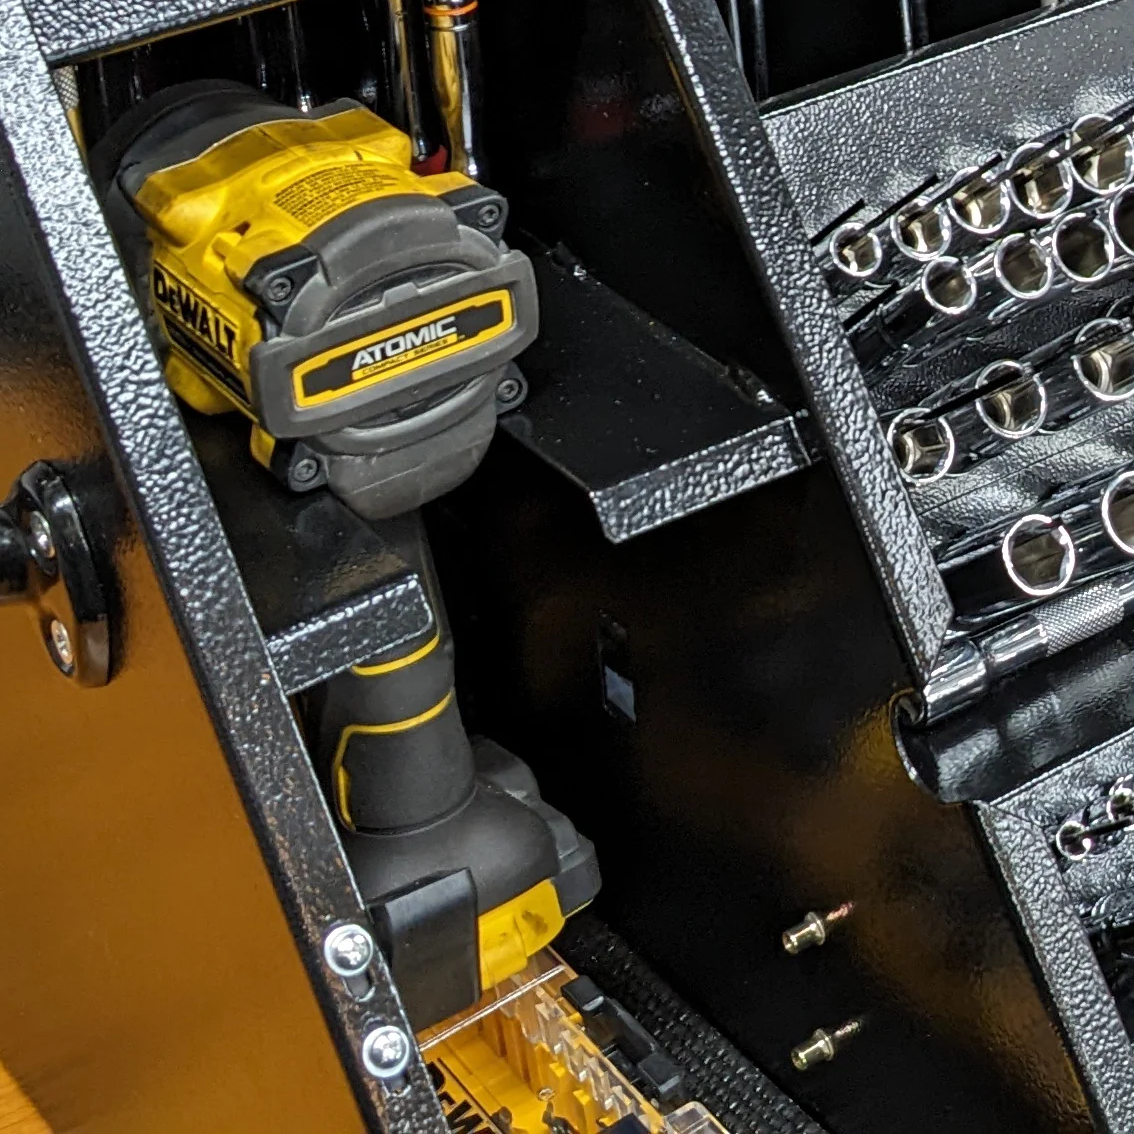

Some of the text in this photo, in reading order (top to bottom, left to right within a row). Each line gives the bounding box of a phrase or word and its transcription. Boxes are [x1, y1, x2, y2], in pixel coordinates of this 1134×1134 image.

[153, 266, 238, 362] DEWALT
[351, 315, 457, 371] ATOMIC
[361, 338, 449, 376] COMPACT SERIES
